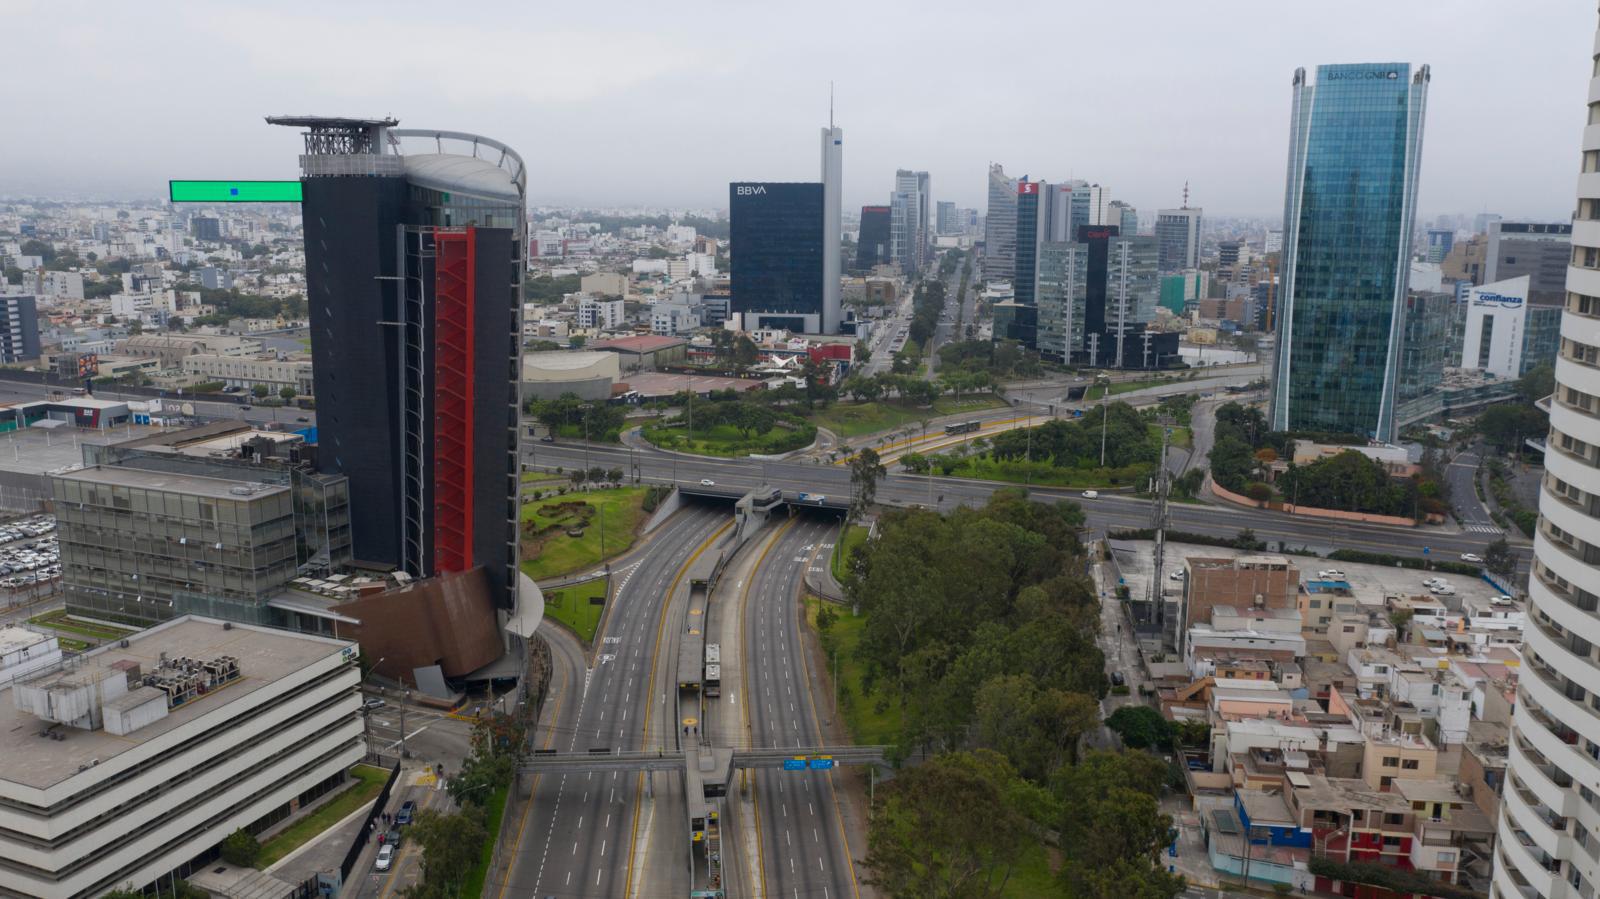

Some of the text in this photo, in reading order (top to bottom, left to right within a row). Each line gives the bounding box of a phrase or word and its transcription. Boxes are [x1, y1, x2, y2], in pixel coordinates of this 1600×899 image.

[1328, 71, 1362, 81] BANCO
[737, 186, 767, 195] BBVA
[1479, 294, 1523, 304] confianza
